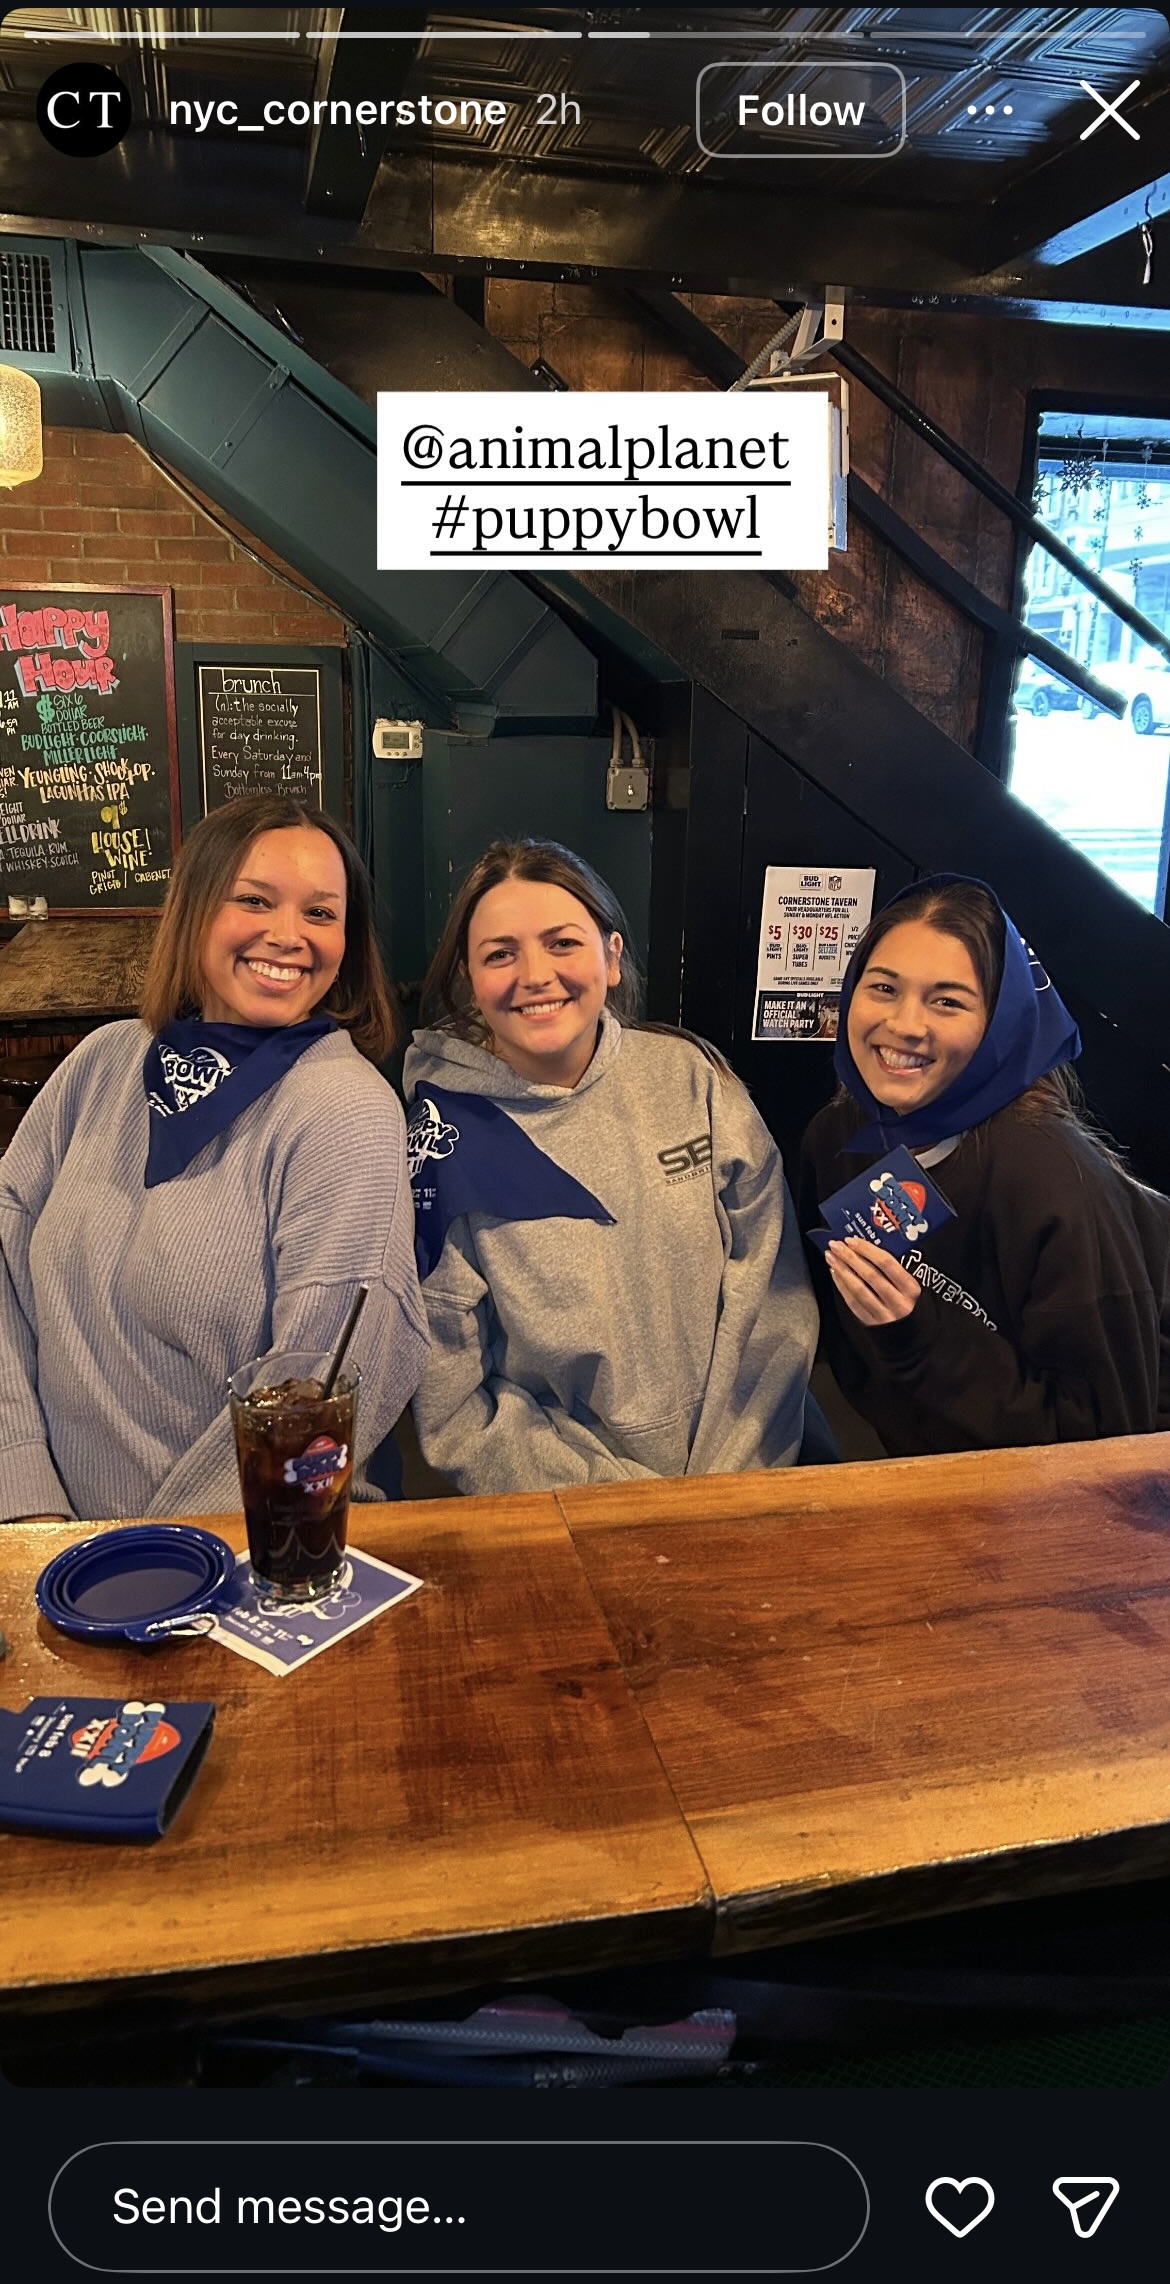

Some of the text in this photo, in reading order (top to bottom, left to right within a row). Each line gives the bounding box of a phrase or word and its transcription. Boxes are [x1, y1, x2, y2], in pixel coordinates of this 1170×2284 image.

[221, 669, 282, 694] brunch
[258, 698, 299, 717] socially
[41, 716, 105, 734] BOTTLED BEER
[211, 715, 298, 728] acceptable excuse
[212, 727, 299, 750] for day drinking.
[211, 745, 312, 767] Every Saturday and
[212, 764, 250, 784] Sunday
[253, 763, 276, 779] from
[91, 869, 116, 884] PINOT
[778, 896, 858, 907] CORNERSTONE TAVERN
[768, 925, 782, 940] $5
[792, 925, 813, 940] $30
[819, 926, 839, 941] $25
[764, 1001, 806, 1010] MAKE IT AN
[763, 1010, 797, 1019] OFFICIAL
[762, 1019, 814, 1028] WATCH PARTY
[855, 1212, 867, 1227] sun
[870, 1201, 896, 1234] XXII
[304, 1475, 334, 1493] XXII
[70, 1718, 110, 1758] XXII
